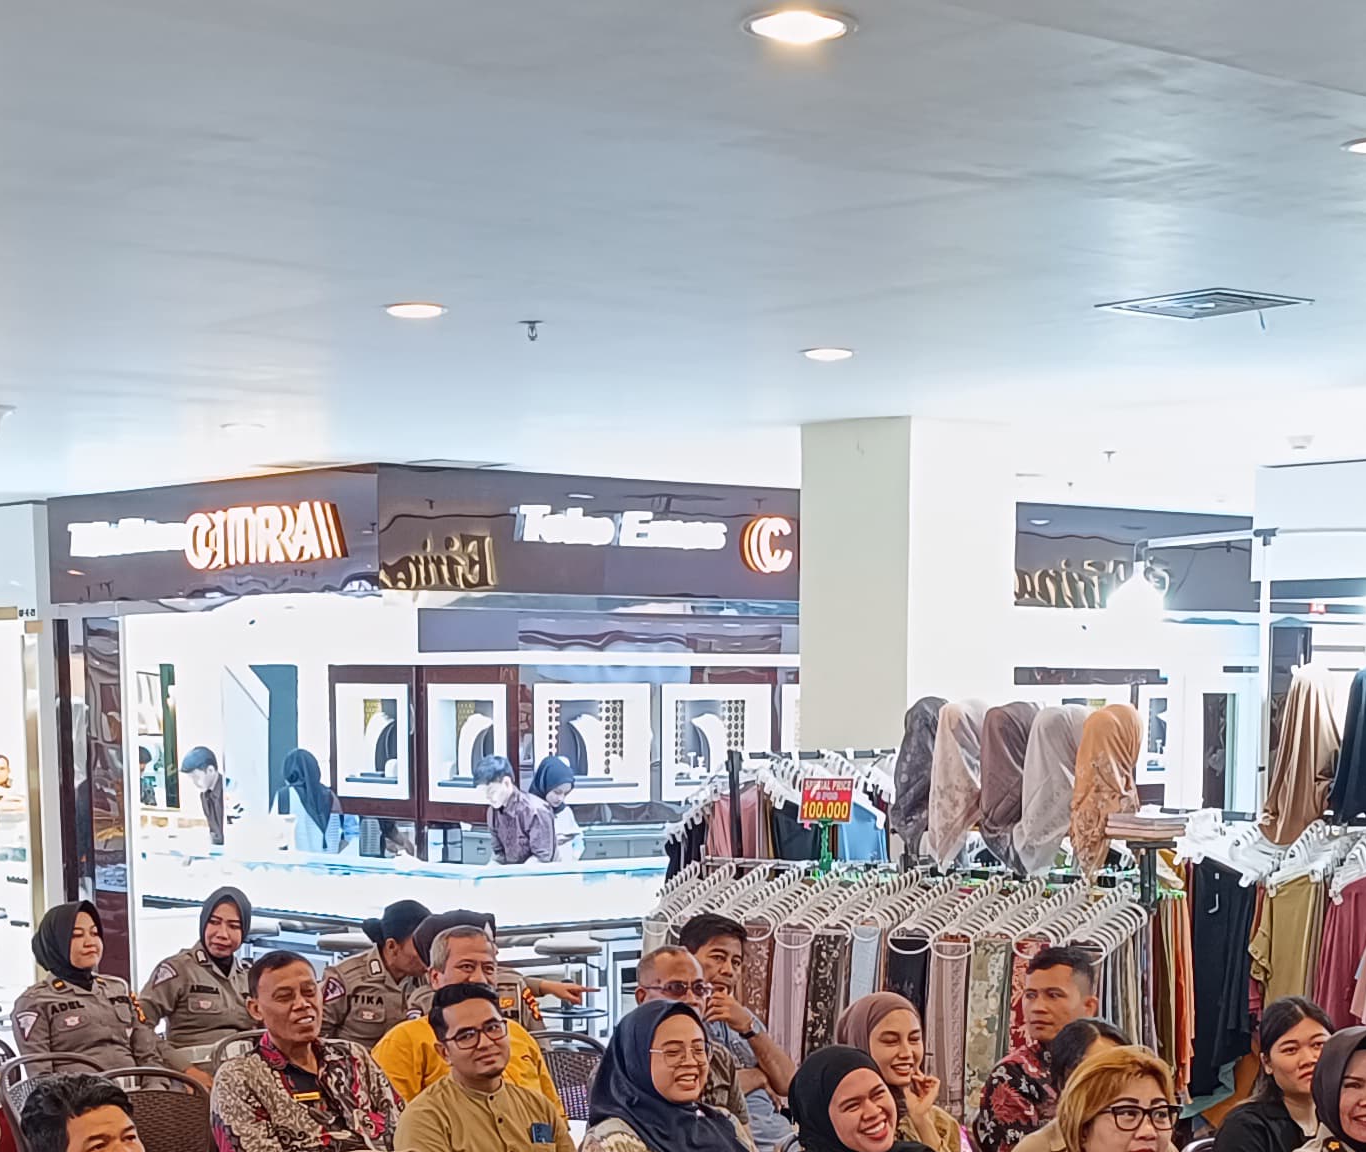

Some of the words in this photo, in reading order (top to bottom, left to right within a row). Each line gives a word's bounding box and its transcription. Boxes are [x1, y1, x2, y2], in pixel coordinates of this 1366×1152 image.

[802, 801, 849, 819] 100.000
[353, 994, 384, 1005] TIKA
[51, 1000, 86, 1015] ADEL
